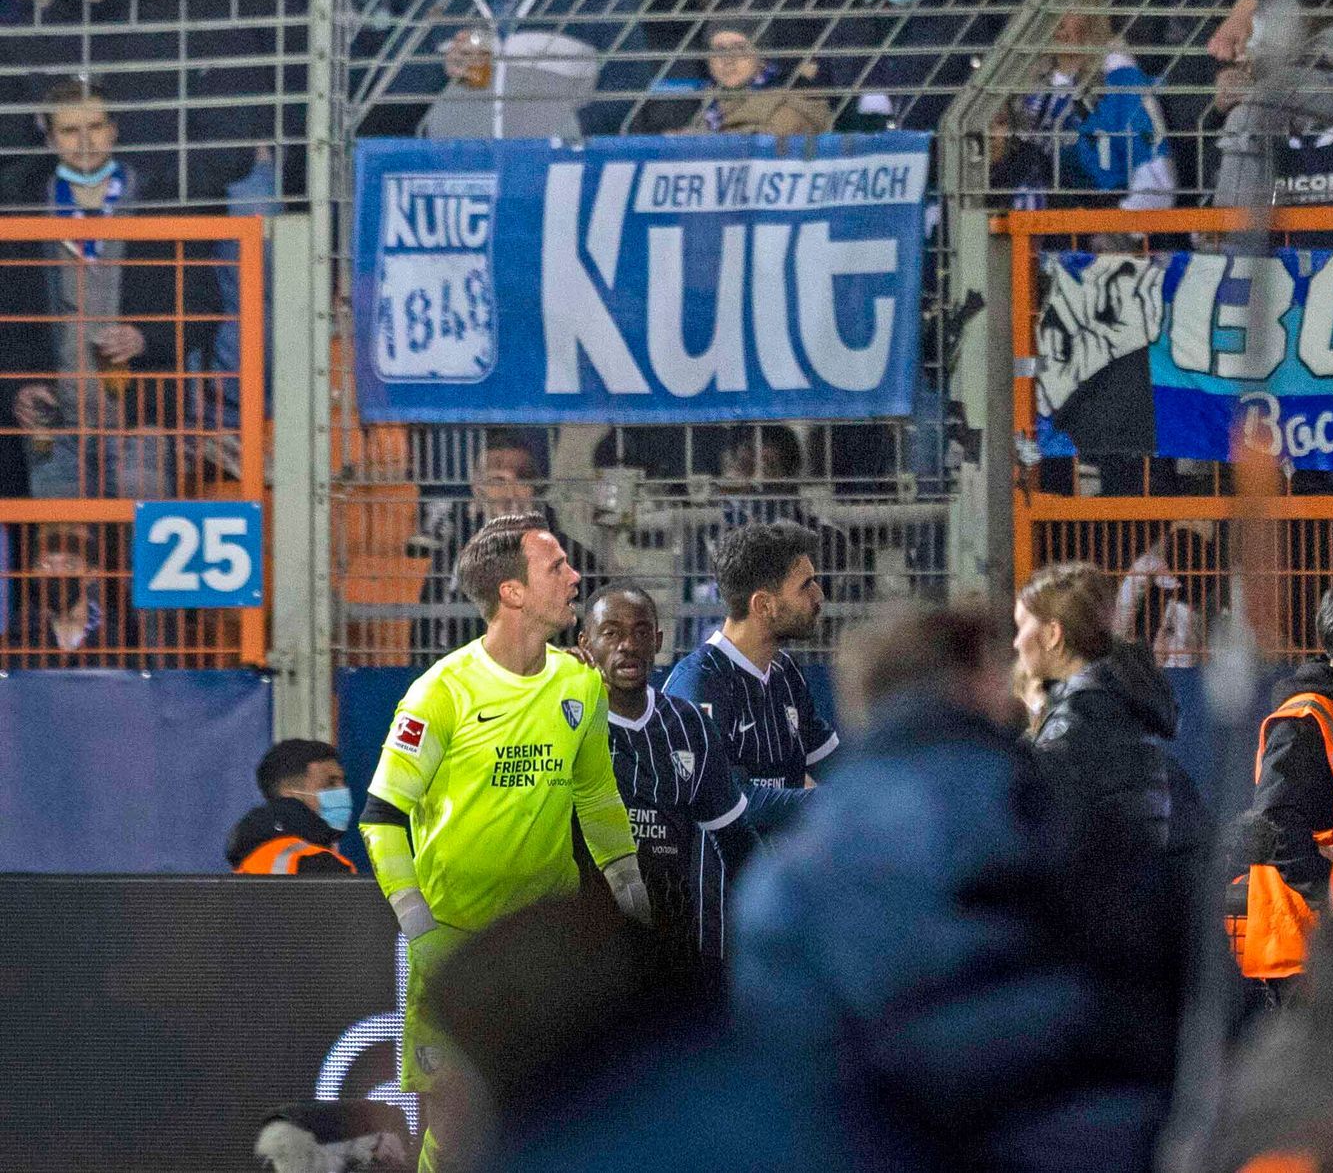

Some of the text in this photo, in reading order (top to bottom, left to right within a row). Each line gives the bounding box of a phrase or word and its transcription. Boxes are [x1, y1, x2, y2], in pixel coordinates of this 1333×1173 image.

[652, 173, 705, 207] DER
[755, 171, 803, 205] IST
[806, 165, 911, 203] EINFACH
[541, 160, 898, 399] Kult
[147, 515, 252, 593] 25
[495, 743, 554, 759] VEREINT
[494, 758, 563, 773] FRIEDLICH
[491, 773, 535, 787] LEBEN
[750, 777, 786, 789] EREINT
[628, 808, 658, 823] EINT
